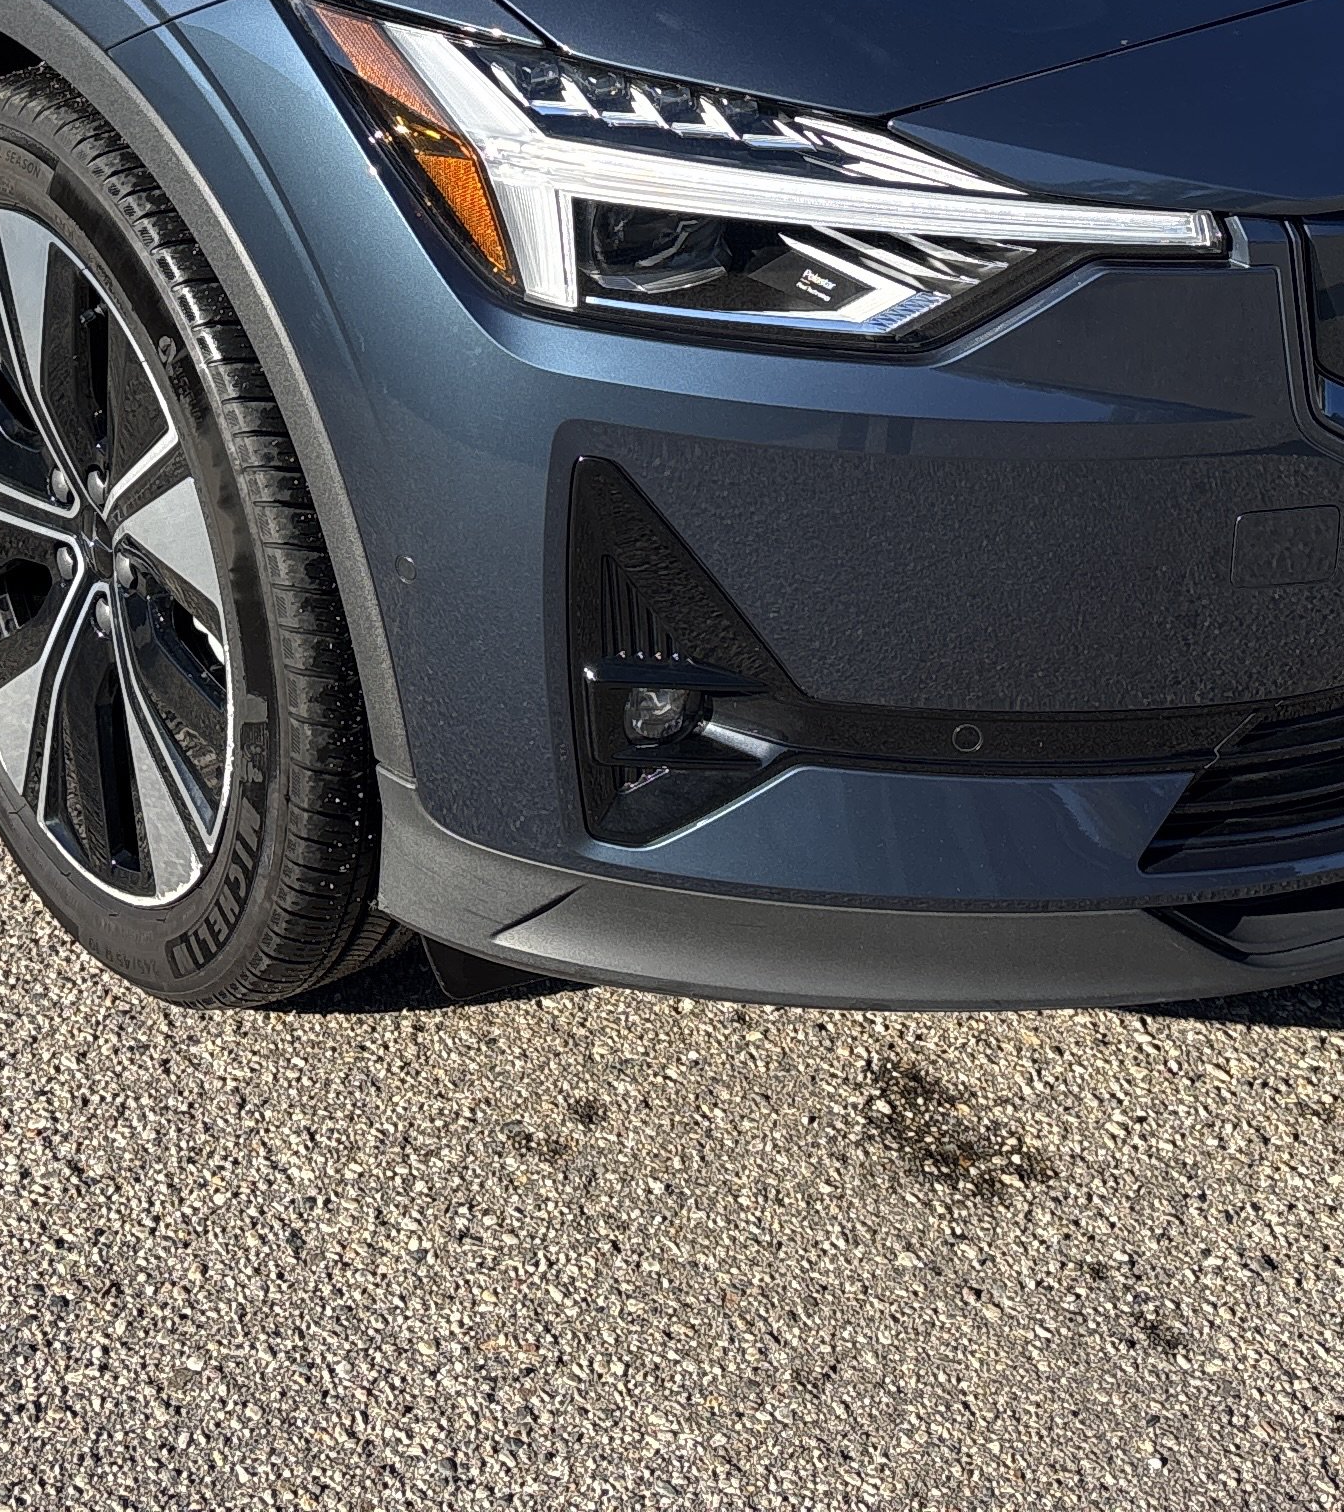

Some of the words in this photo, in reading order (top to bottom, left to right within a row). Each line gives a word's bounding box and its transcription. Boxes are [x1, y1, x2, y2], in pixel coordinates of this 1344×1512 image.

[5, 150, 42, 179] SEASON
[802, 268, 836, 290] Polestar
[171, 796, 261, 976] MICHELIN
